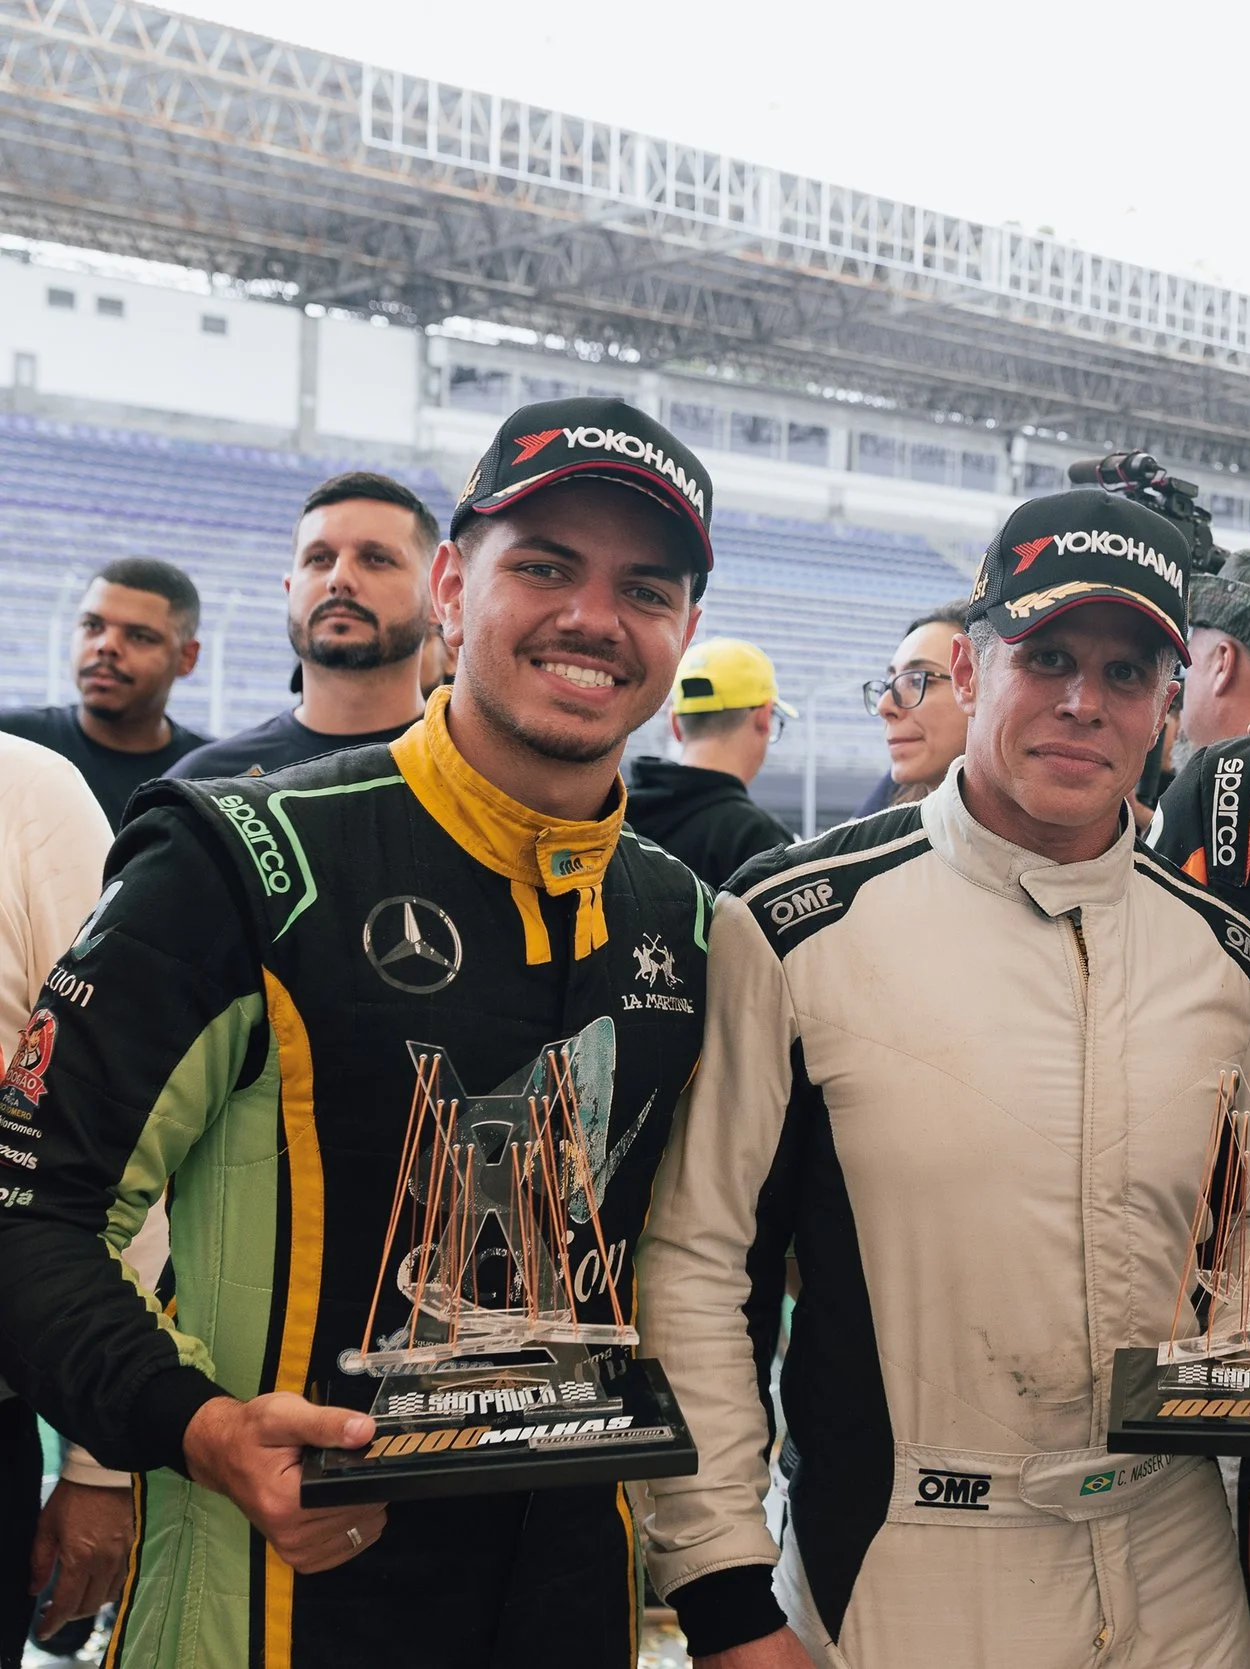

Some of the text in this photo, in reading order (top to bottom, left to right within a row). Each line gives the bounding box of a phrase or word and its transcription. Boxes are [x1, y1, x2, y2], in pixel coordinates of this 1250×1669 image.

[563, 426, 705, 519] YOKOHAMA
[1053, 529, 1183, 598] YOKOHAMA
[1213, 757, 1244, 867] sparco
[216, 793, 291, 897] sparco
[770, 883, 834, 926] OMP
[621, 993, 643, 1010] LA
[917, 1475, 991, 1505] OMP
[1117, 1470, 1128, 1487] C.
[1130, 1454, 1164, 1482] NASSER
